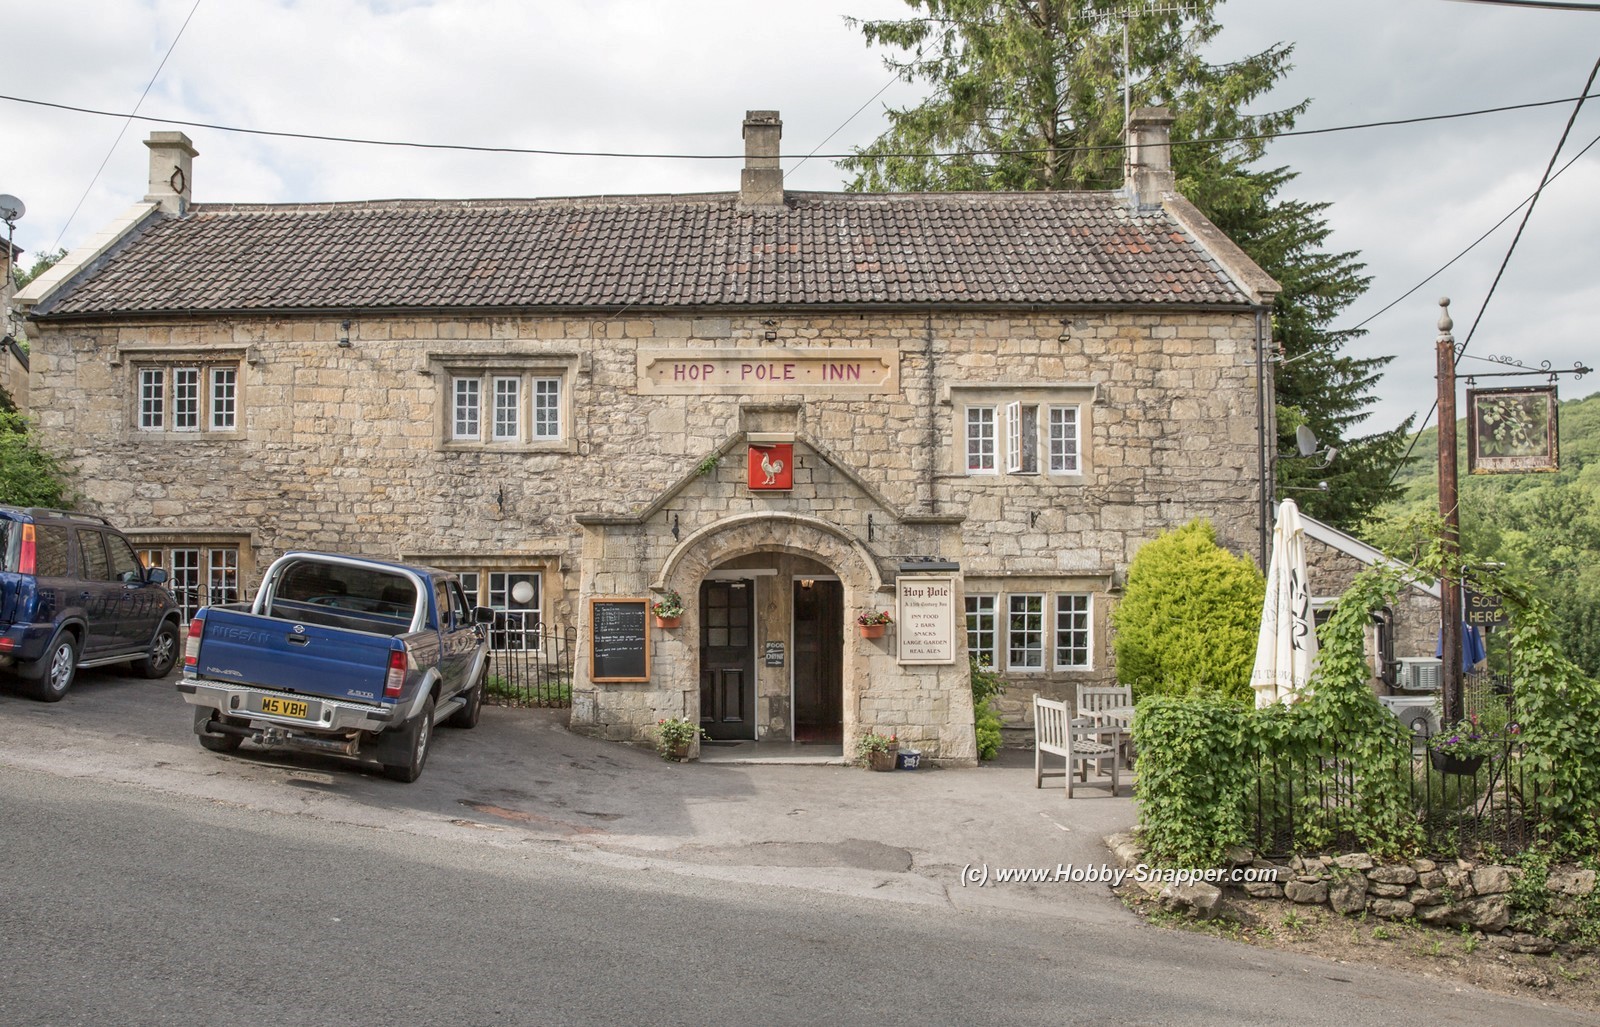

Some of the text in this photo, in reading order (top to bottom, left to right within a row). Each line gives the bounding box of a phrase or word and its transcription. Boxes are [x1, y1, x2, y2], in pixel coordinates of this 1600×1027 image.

[674, 363, 861, 381] HOP POLE INN
[903, 586, 948, 598] Hop Pole
[1470, 611, 1502, 622] HERE
[212, 625, 272, 643] NISSAN
[262, 698, 307, 717] M5 VBH
